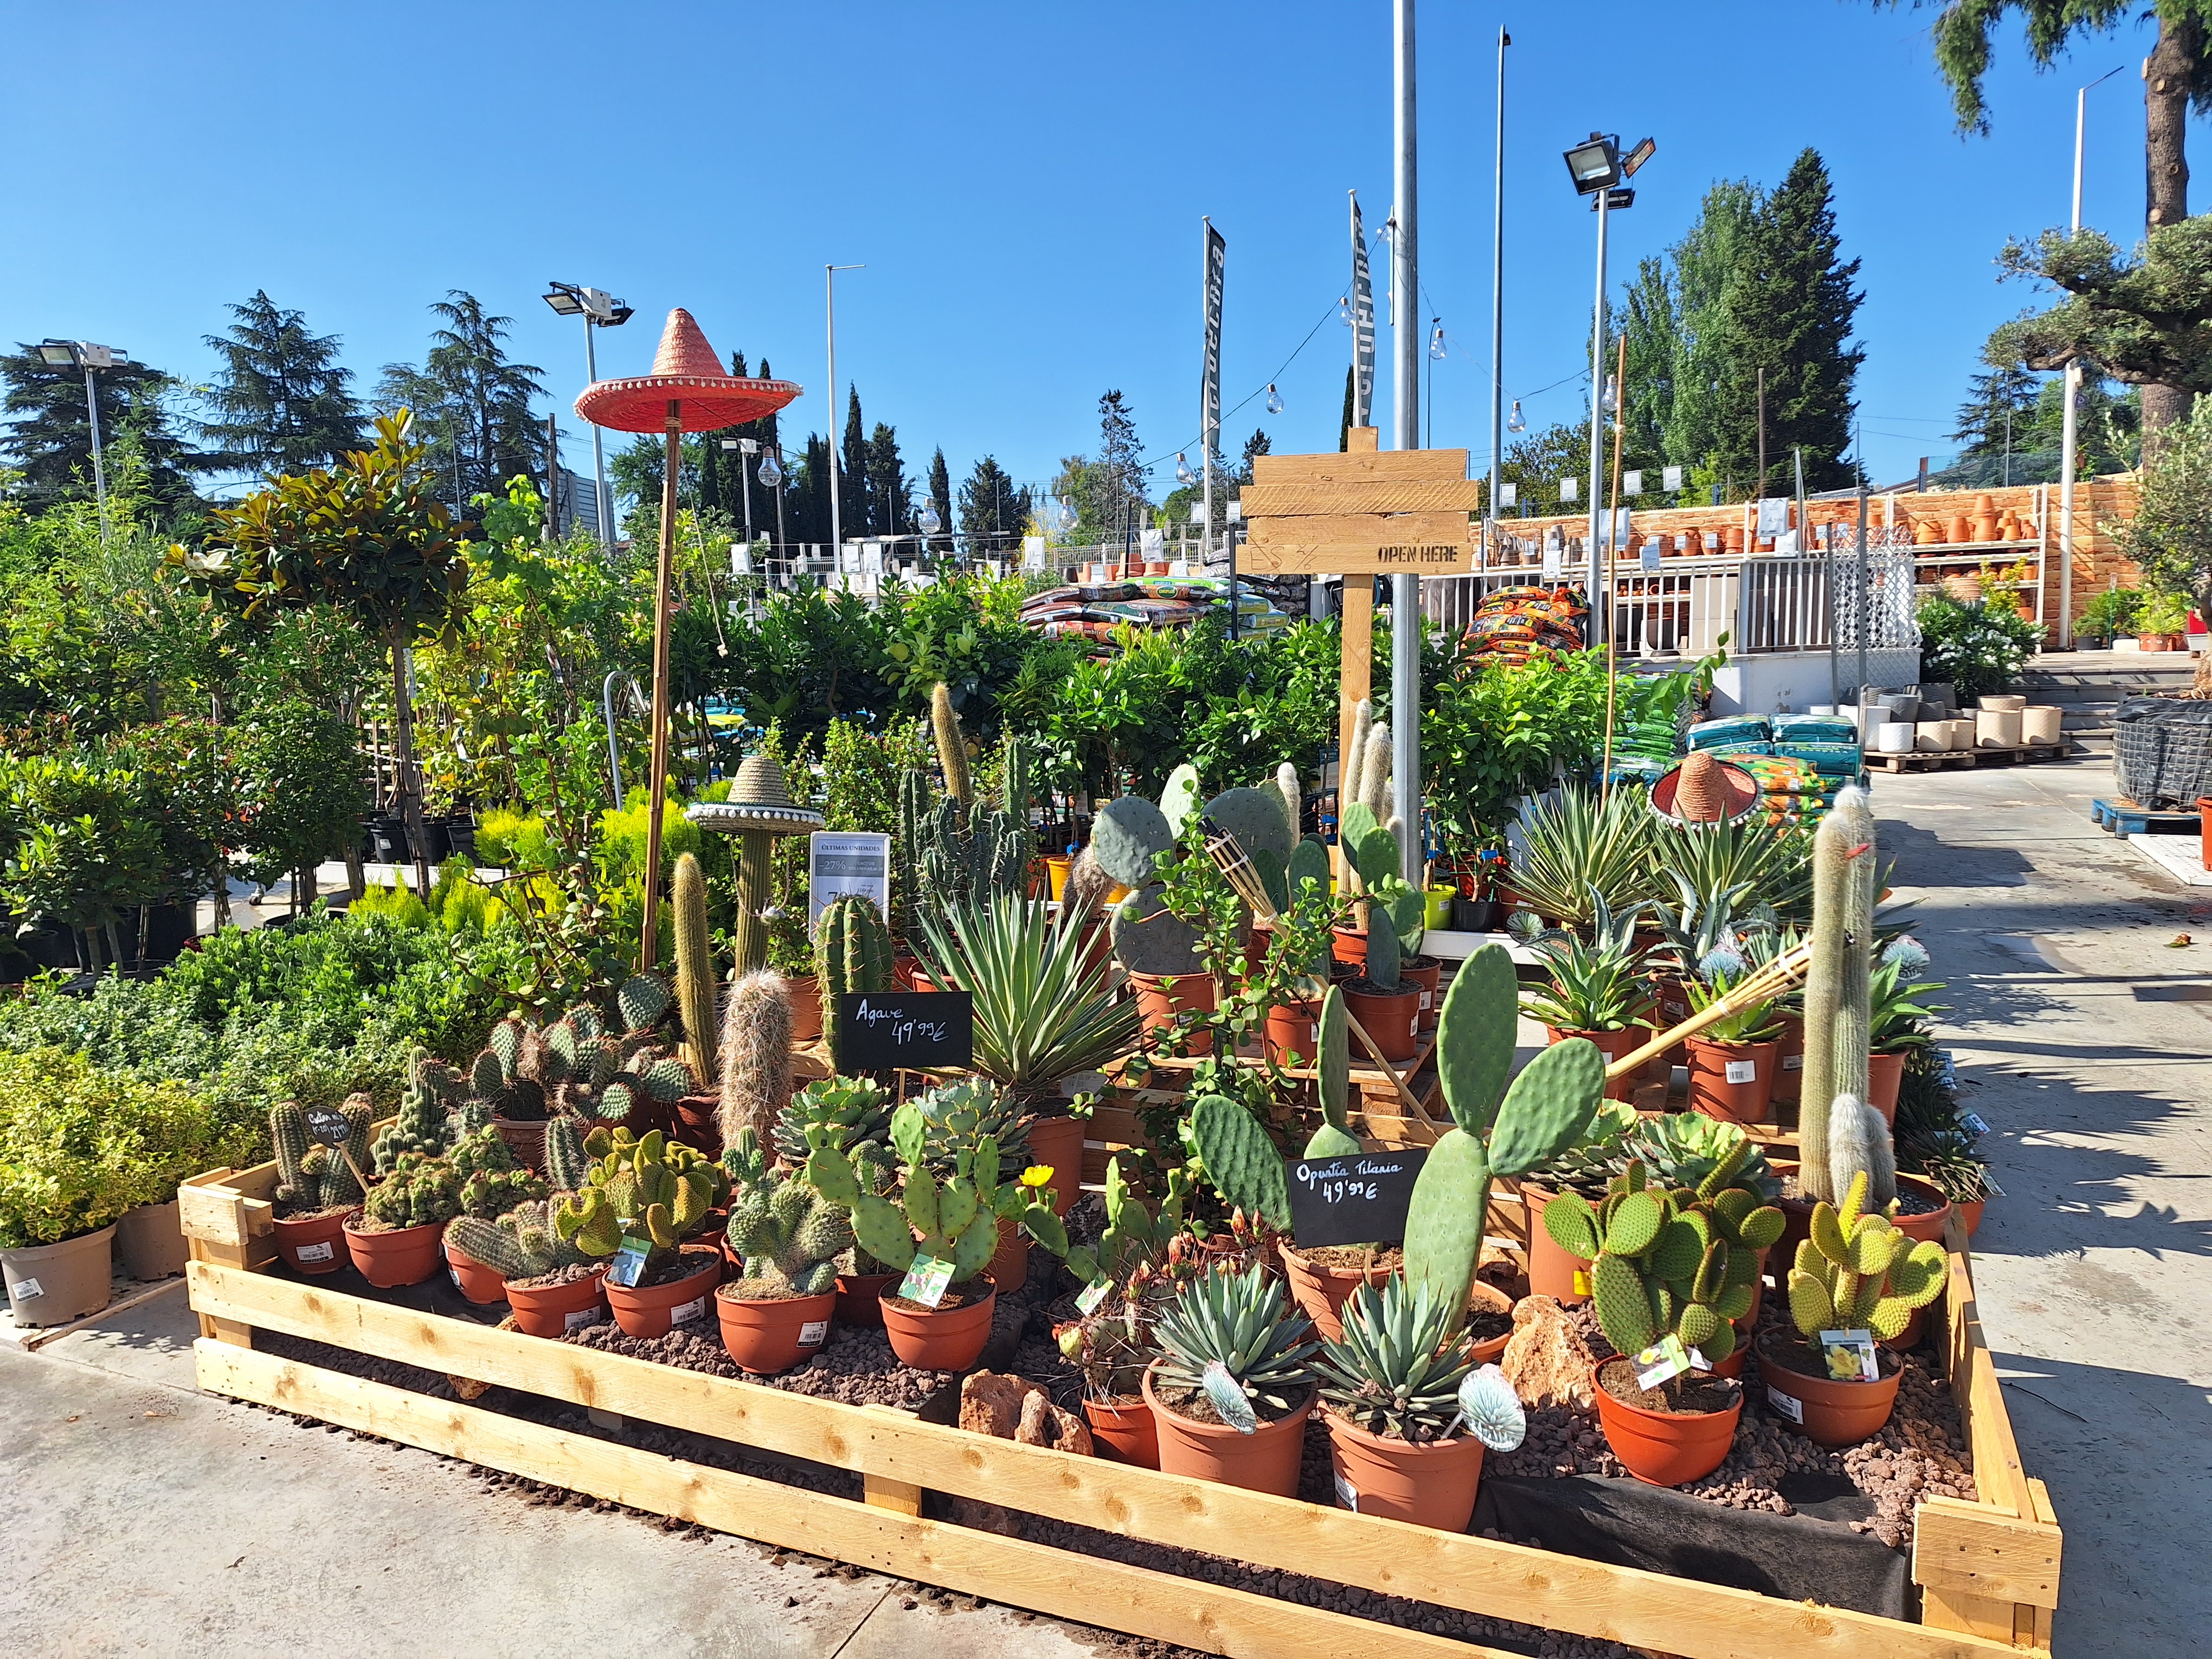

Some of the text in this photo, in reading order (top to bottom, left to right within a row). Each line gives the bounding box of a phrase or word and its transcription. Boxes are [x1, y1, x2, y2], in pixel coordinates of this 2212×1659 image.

[1378, 545, 1457, 563] OPEN HERE
[818, 860, 846, 871] -27%
[856, 998, 904, 1028] Agave
[1296, 1161, 1349, 1191] Opuntia
